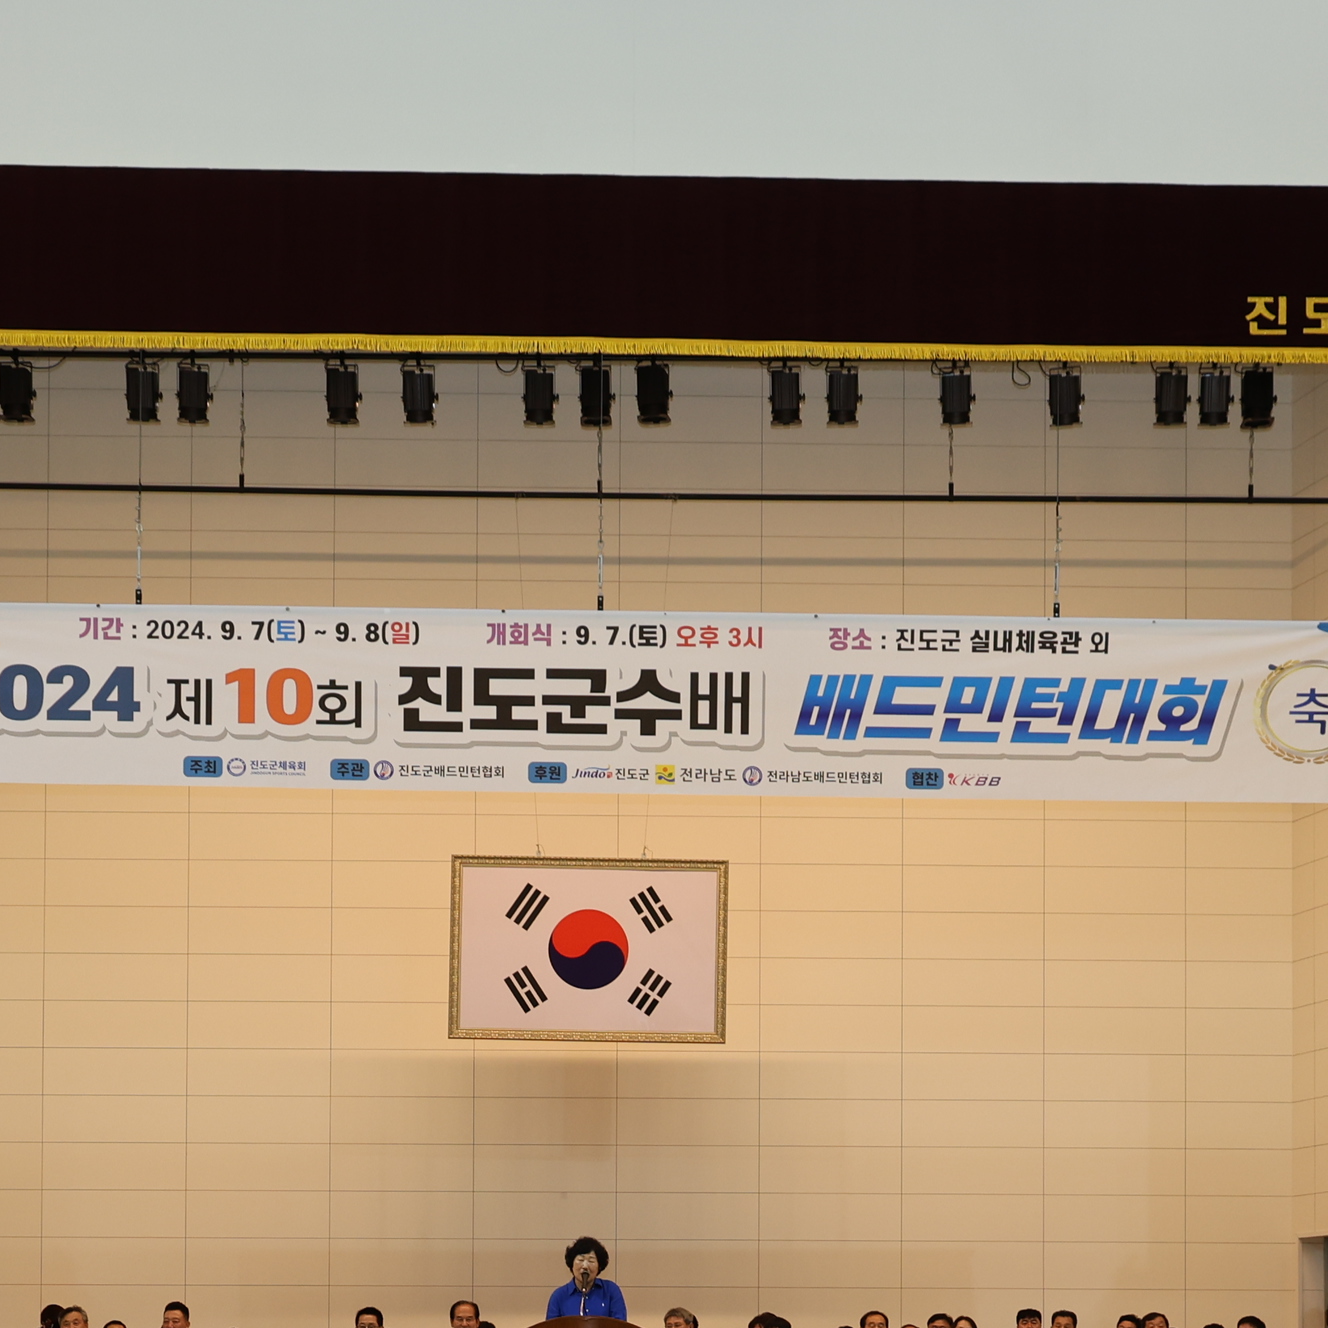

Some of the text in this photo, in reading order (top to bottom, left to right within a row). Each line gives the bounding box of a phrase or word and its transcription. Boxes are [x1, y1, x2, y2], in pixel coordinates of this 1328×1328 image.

[78, 617, 123, 640] 기간
[146, 619, 212, 640] 2024.
[486, 622, 553, 648] 개회식
[676, 625, 719, 648] 오후
[728, 626, 764, 649] 3시
[828, 627, 872, 652] 장소
[895, 628, 961, 653] 진도군
[970, 629, 1082, 655] 실내체육관
[1090, 631, 1110, 655] 외
[165, 666, 363, 729] 제10회
[397, 665, 751, 738] 진도군수배
[793, 673, 1229, 746] 배드민턴대회
[190, 760, 217, 775] 주최
[250, 760, 307, 771] 진도군체육회
[337, 762, 365, 778] 주관
[398, 764, 505, 779] 진도군배드민턴협회
[534, 765, 561, 781] 후원
[572, 768, 607, 779] Jindo
[615, 767, 650, 781] 진도군
[680, 767, 737, 783] 전라남도
[767, 769, 883, 785] 전라남도배드민턴협회
[912, 771, 939, 787] 협찬
